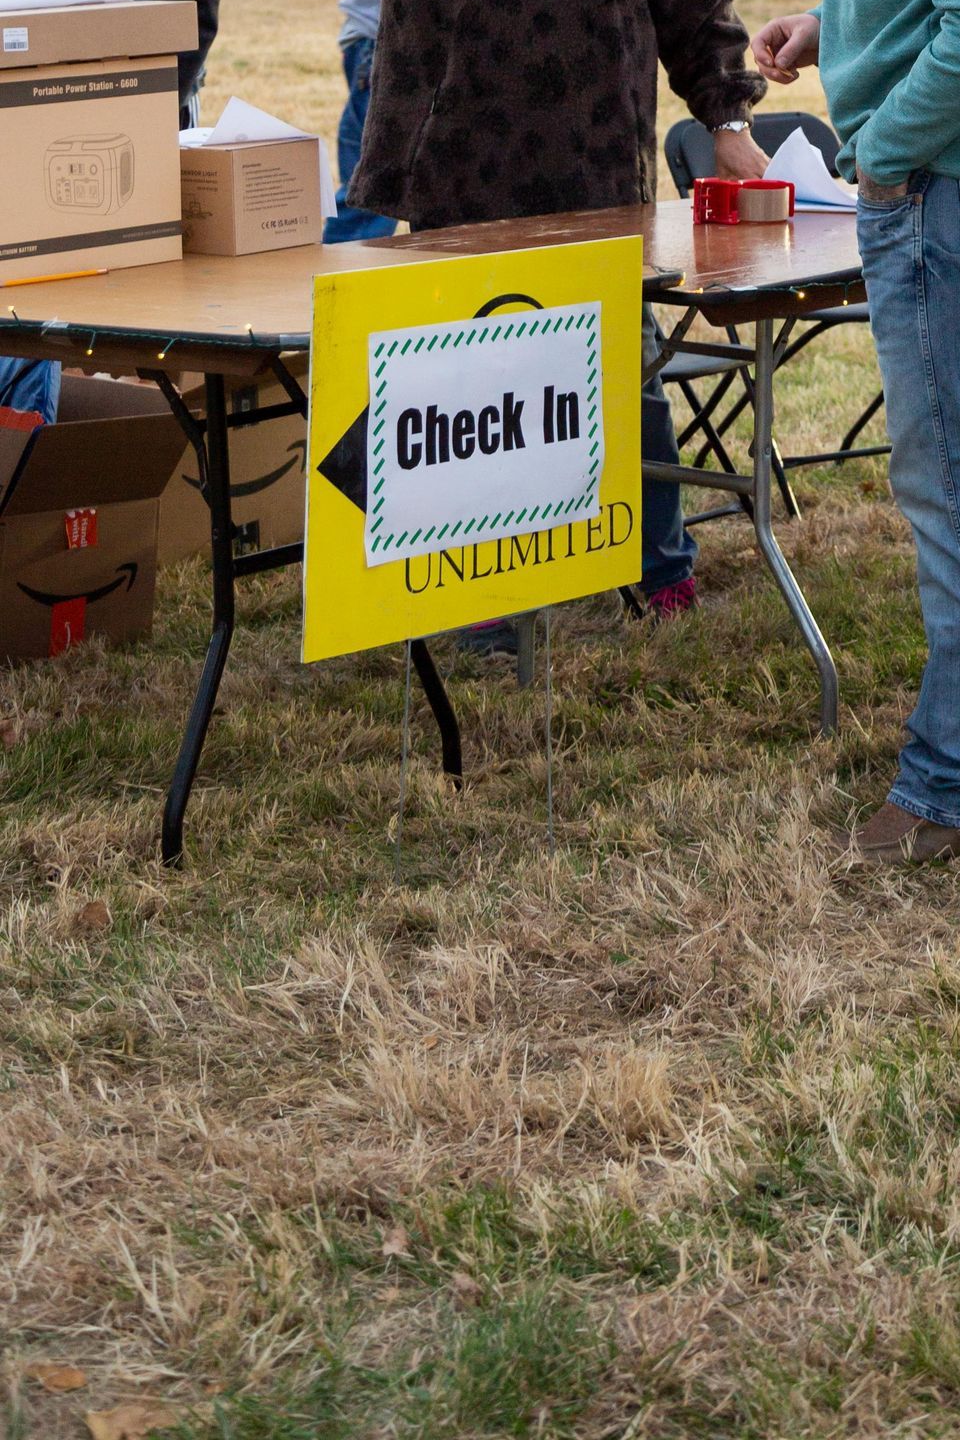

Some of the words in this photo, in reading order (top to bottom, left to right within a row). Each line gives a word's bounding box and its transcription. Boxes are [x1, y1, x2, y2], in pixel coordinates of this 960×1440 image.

[33, 85, 64, 97] Portable
[65, 82, 87, 94] Power
[88, 80, 114, 92] Station
[120, 77, 138, 89] G600
[397, 392, 526, 470] Check
[543, 385, 580, 444] In
